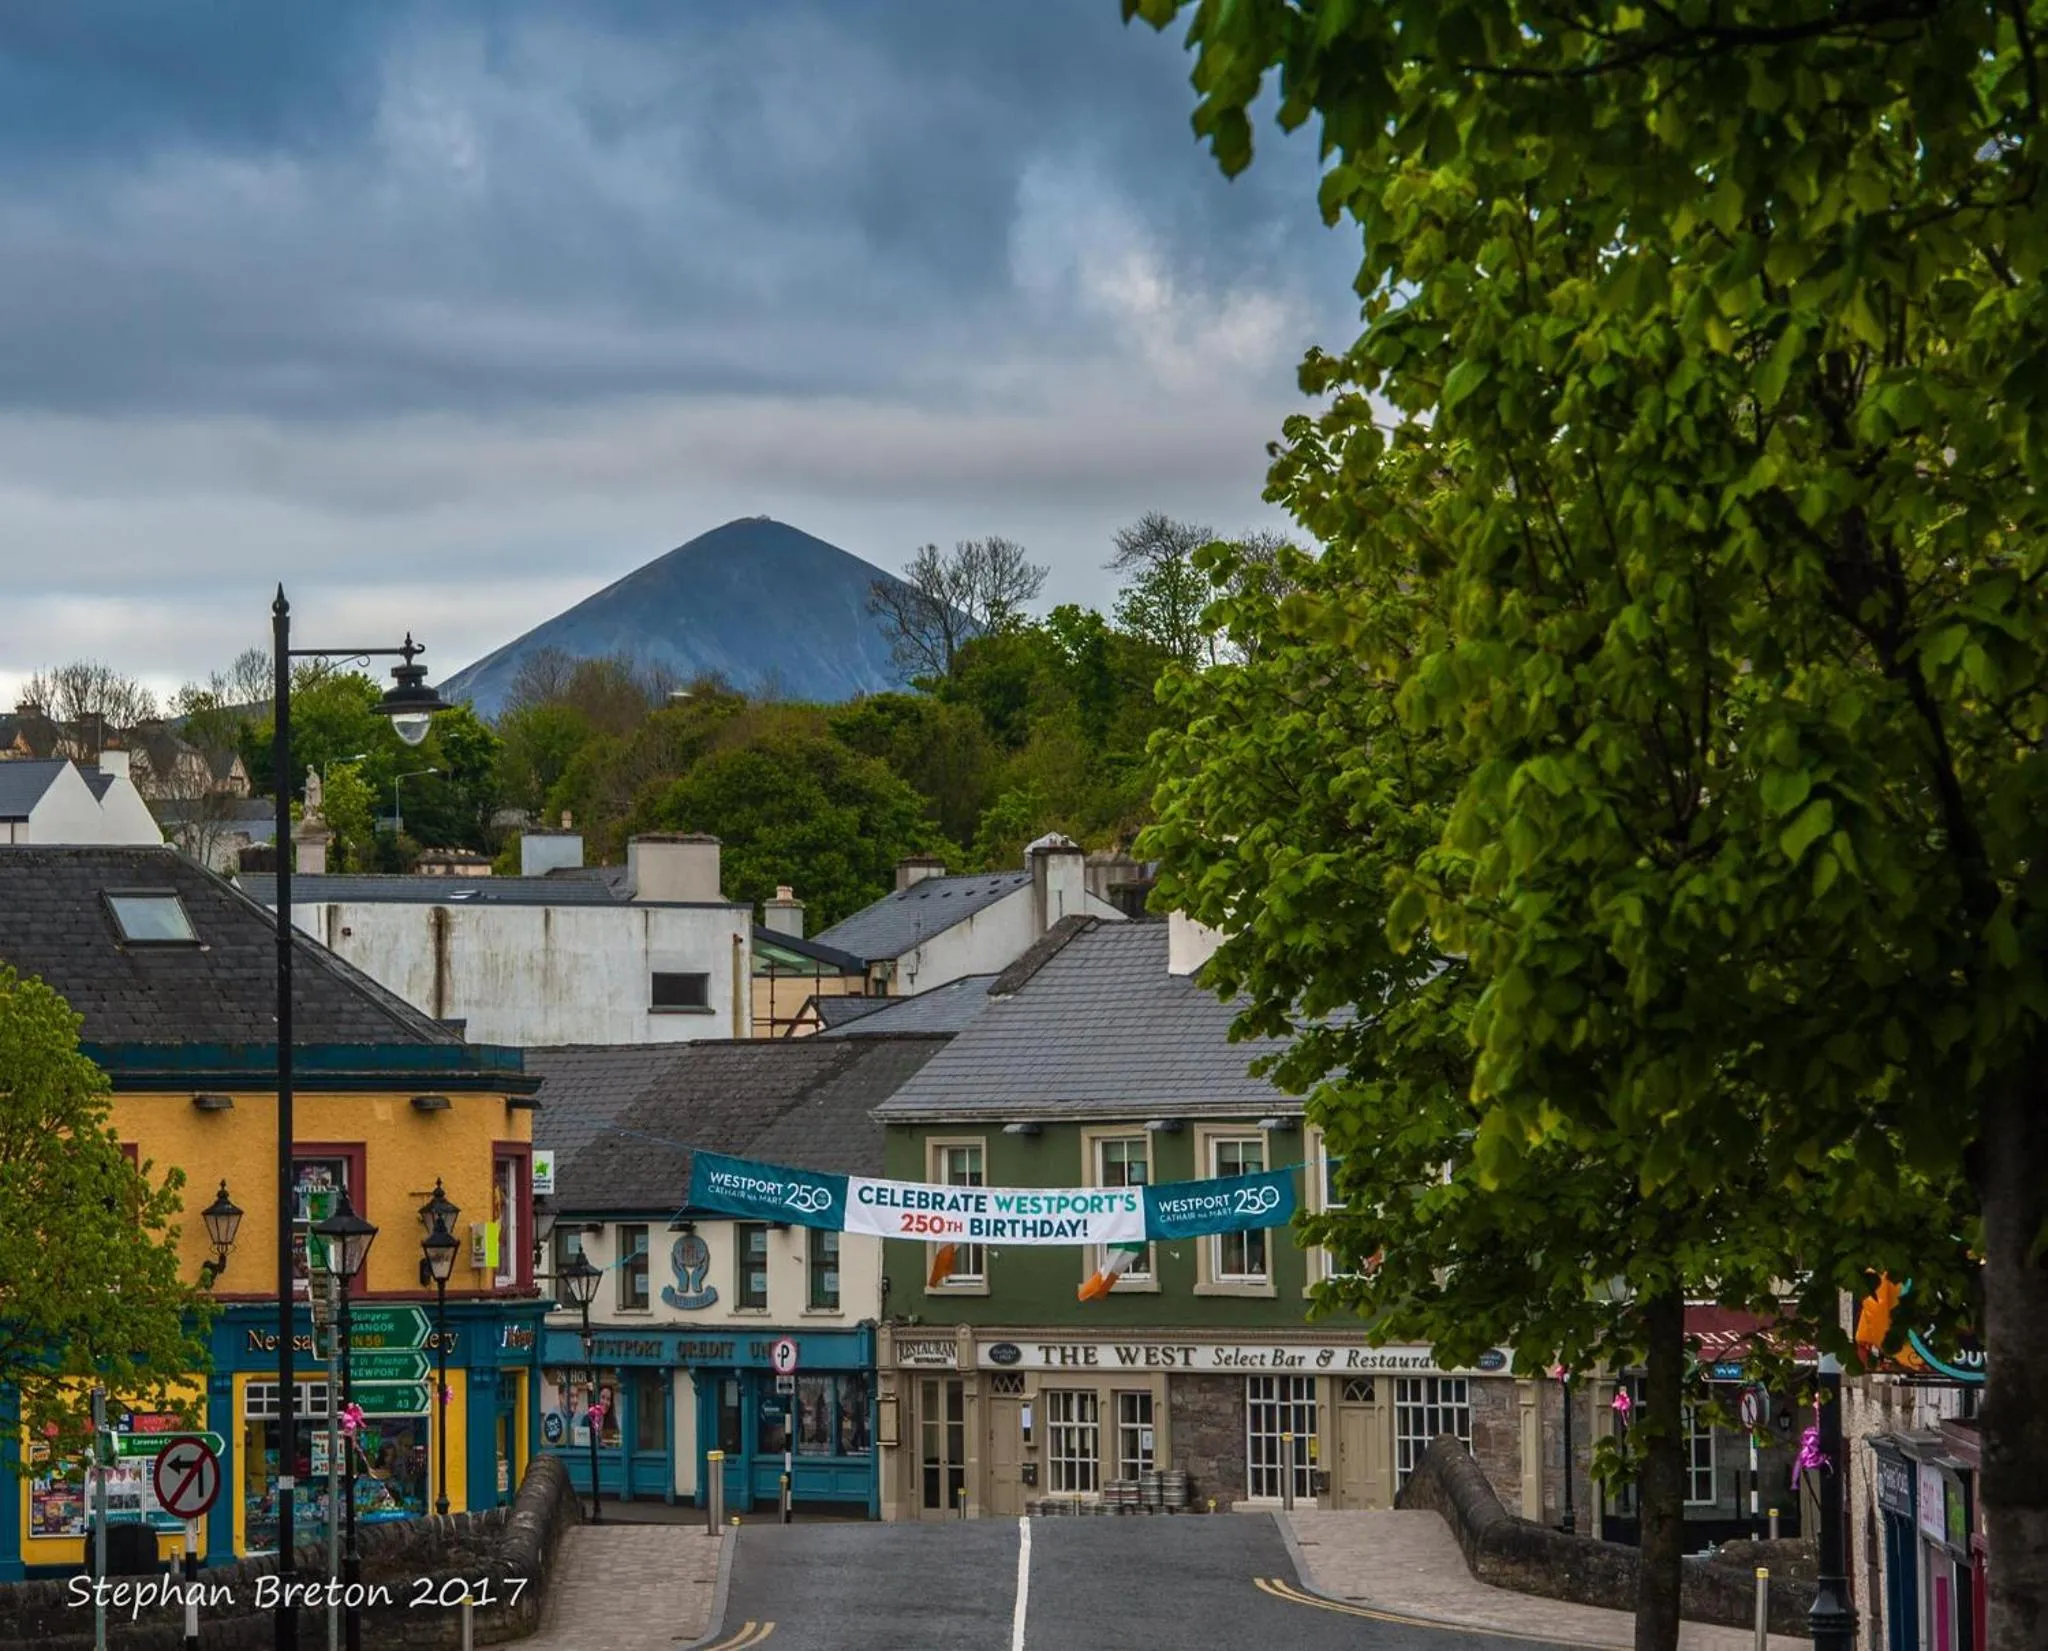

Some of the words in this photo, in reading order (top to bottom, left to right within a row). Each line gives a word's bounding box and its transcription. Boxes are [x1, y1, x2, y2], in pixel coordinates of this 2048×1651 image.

[708, 1185, 746, 1200] CATHAIR
[710, 1171, 783, 1196] WESTPORT
[785, 1183, 832, 1213] 250
[858, 1186, 987, 1213] CELEBRATE
[993, 1194, 1137, 1215] WESTPORT'S
[1158, 1193, 1230, 1213] WESTPORT
[1234, 1185, 1280, 1215] 250
[900, 1213, 963, 1234] 250TH
[969, 1218, 1089, 1238] BIRTHDAY!
[1159, 1212, 1195, 1223] CATHAIR
[1038, 1345, 1099, 1366] THE
[1114, 1346, 1197, 1367] WEST
[1212, 1347, 1266, 1367] Select
[1271, 1348, 1306, 1367] Bar
[1316, 1349, 1335, 1368] &
[1347, 1348, 1438, 1368] Restaura
